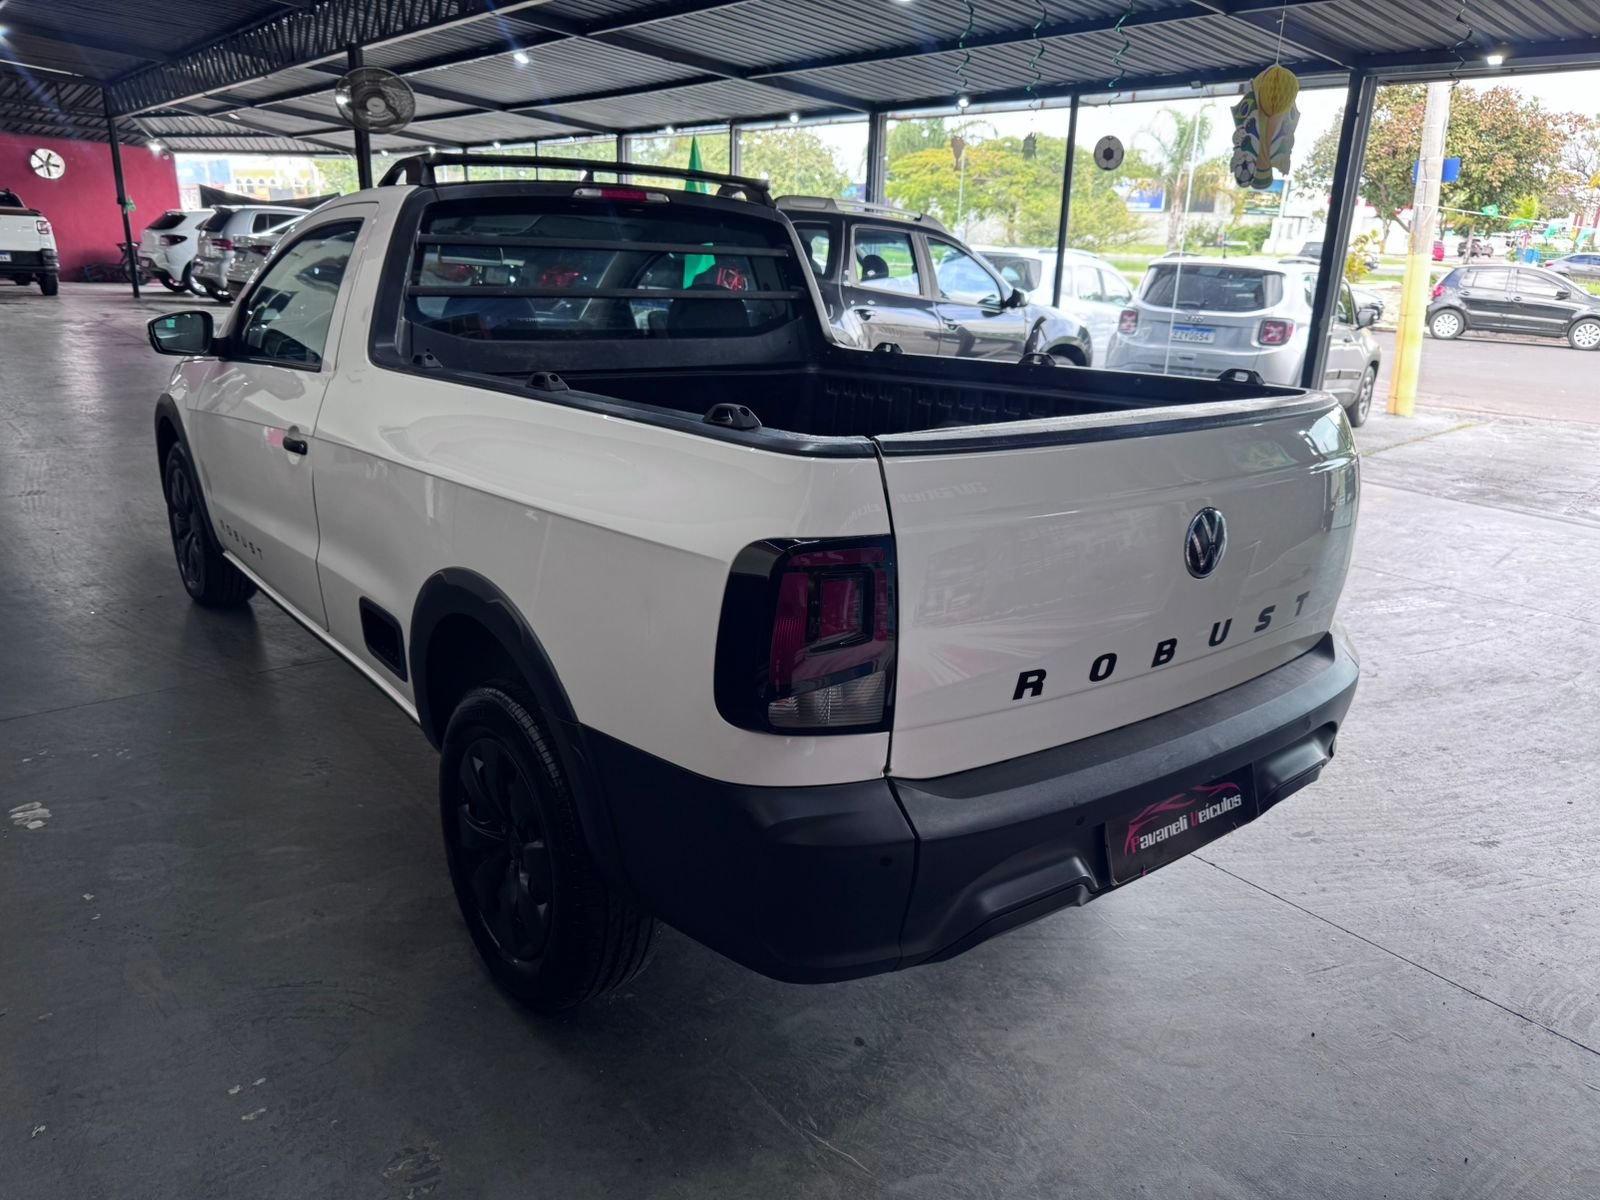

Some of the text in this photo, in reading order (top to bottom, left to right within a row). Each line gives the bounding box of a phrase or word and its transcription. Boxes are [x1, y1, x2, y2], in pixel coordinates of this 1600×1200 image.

[1012, 591, 1310, 700] ROBUST
[1130, 794, 1242, 854] Pavaneli Veículos
